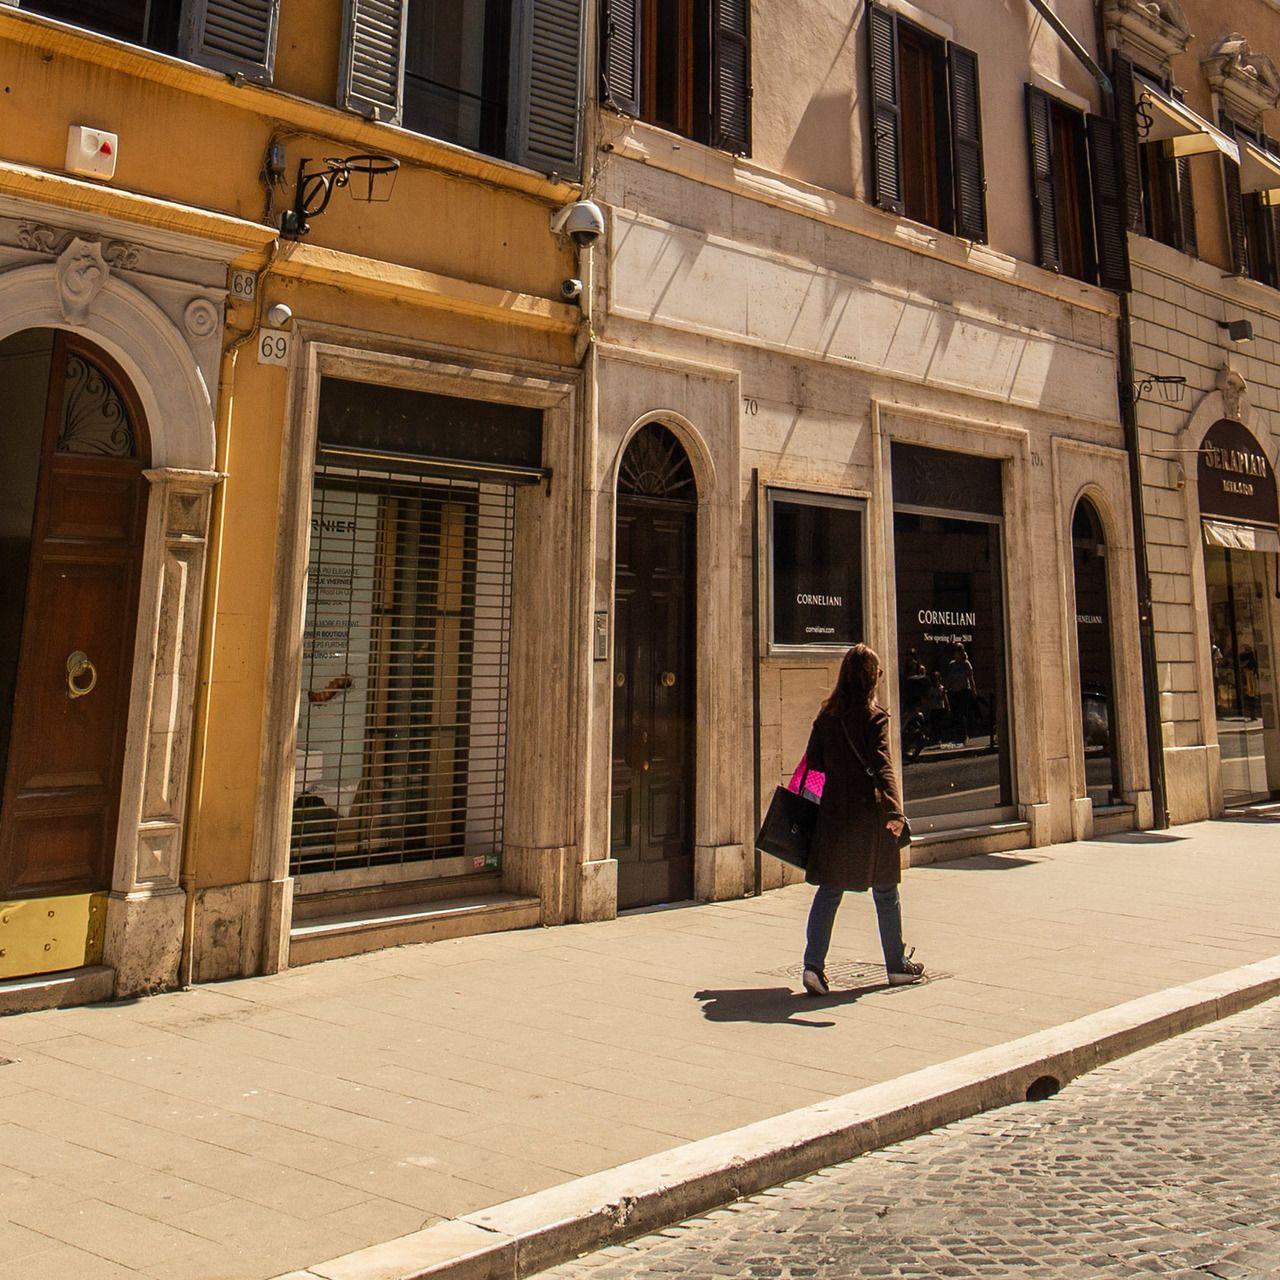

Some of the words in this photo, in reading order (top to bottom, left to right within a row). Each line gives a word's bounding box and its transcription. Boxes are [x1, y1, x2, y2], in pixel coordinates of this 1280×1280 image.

[233, 274, 253, 295] 68
[261, 335, 287, 359] 69
[743, 398, 758, 416] 70
[1204, 439, 1267, 478] SERAPIAN
[1222, 479, 1254, 496] MILANO
[311, 519, 357, 533] RNIER
[326, 578, 352, 586] VHERNIE
[796, 593, 842, 607] CORNELIANI
[918, 609, 976, 626] CORNELIANI
[923, 632, 933, 641] New
[933, 634, 949, 644] opening
